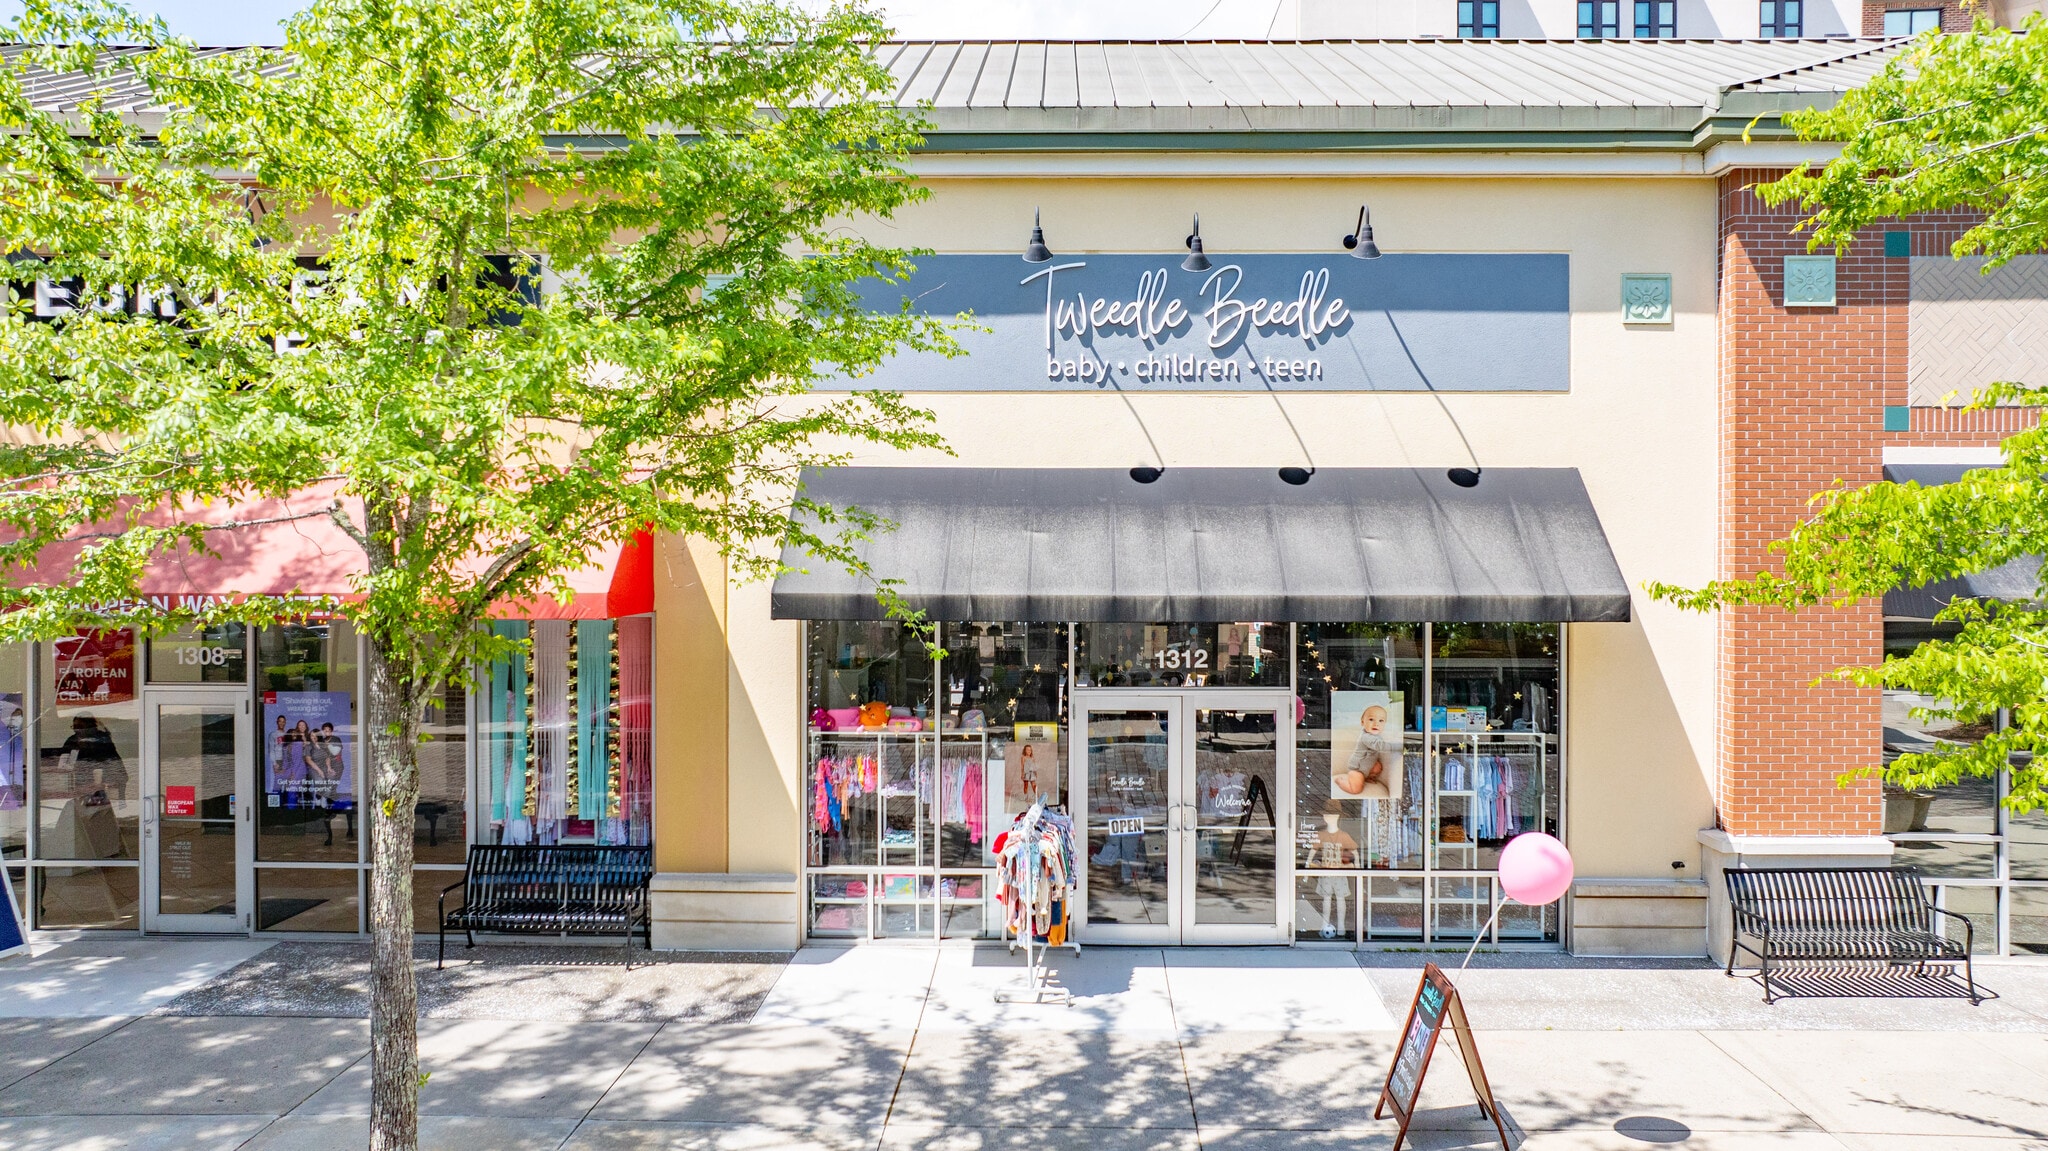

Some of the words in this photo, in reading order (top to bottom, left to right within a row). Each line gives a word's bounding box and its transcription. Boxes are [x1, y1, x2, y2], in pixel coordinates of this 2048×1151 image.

[35, 268, 428, 317] EUREN
[1020, 262, 1188, 350] Tweedle
[1199, 264, 1350, 348] Beedle
[1047, 354, 1108, 383] baby
[1134, 354, 1239, 377] children
[1264, 357, 1322, 377] teen
[244, 595, 341, 617] NTER
[174, 646, 225, 665] 1308
[1154, 648, 1209, 669] 1312
[1215, 793, 1251, 809] Welcome
[1111, 818, 1142, 834] OPEN
